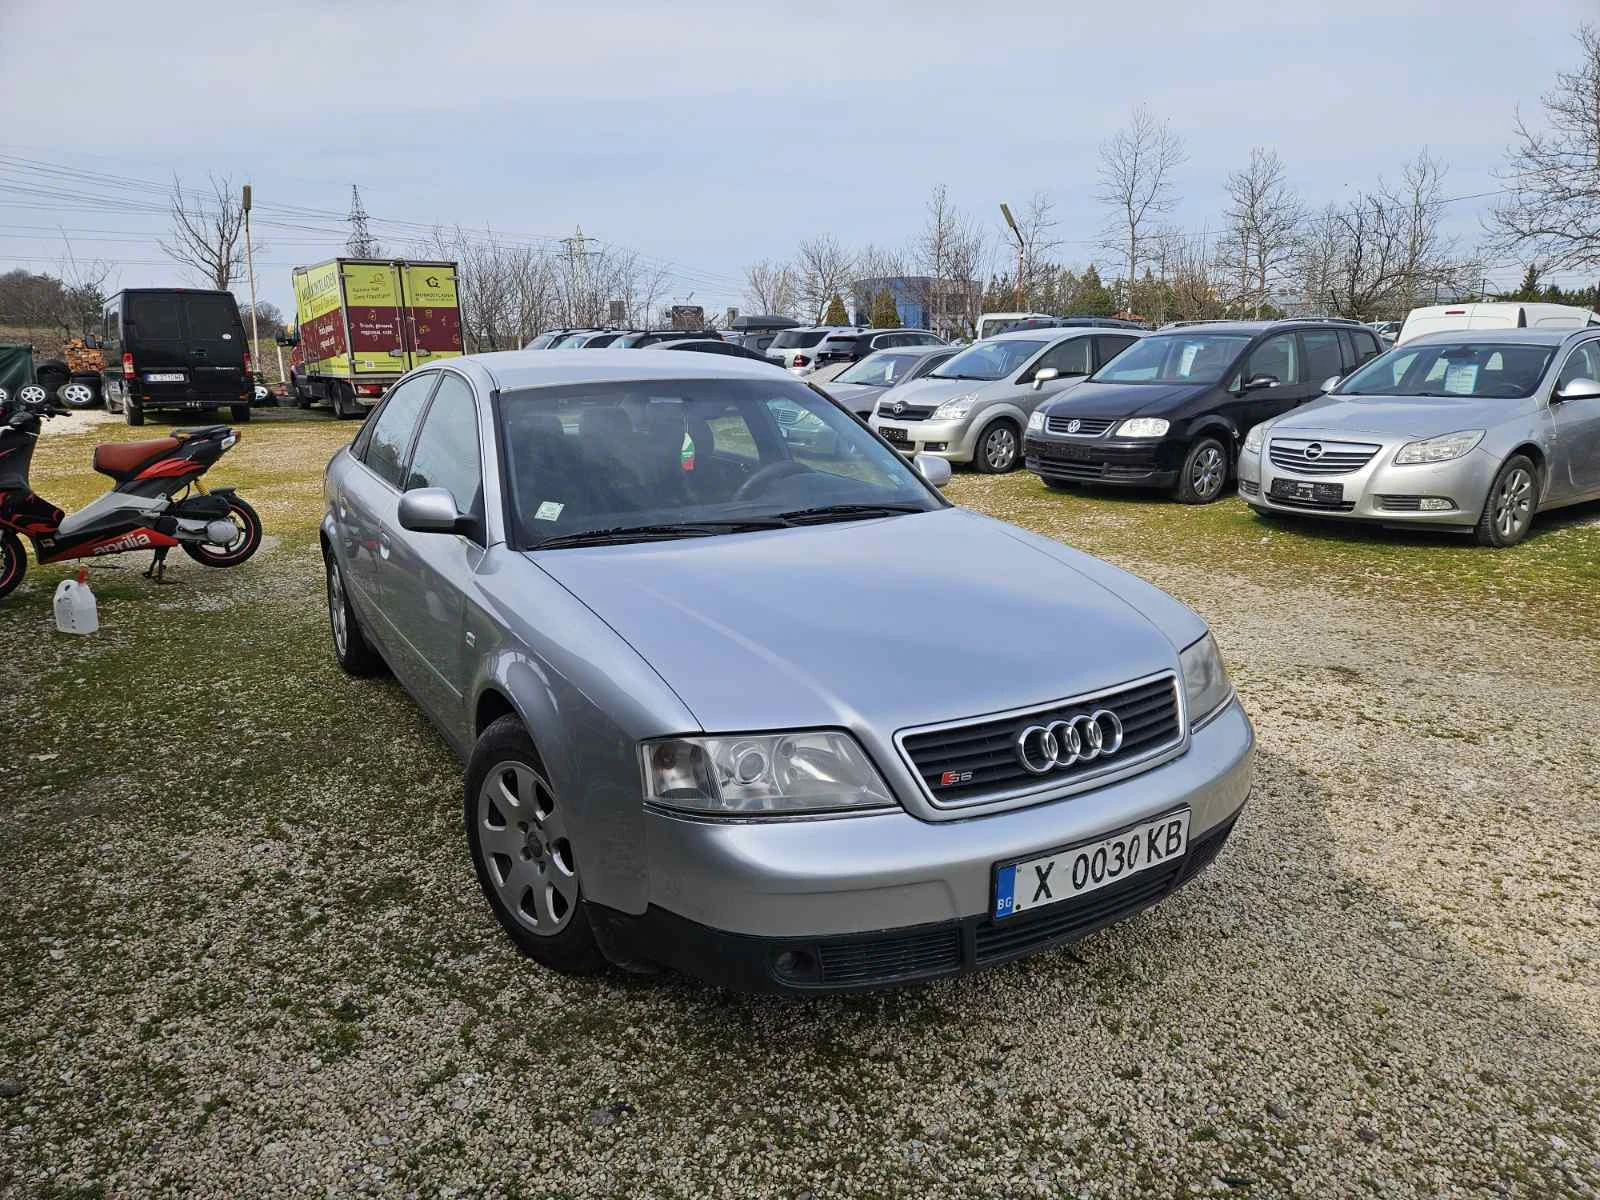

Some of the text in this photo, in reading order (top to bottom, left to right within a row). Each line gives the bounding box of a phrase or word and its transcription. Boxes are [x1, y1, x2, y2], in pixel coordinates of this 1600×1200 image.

[1032, 819, 1182, 902] X 0030 KB
[997, 896, 1013, 910] BG
